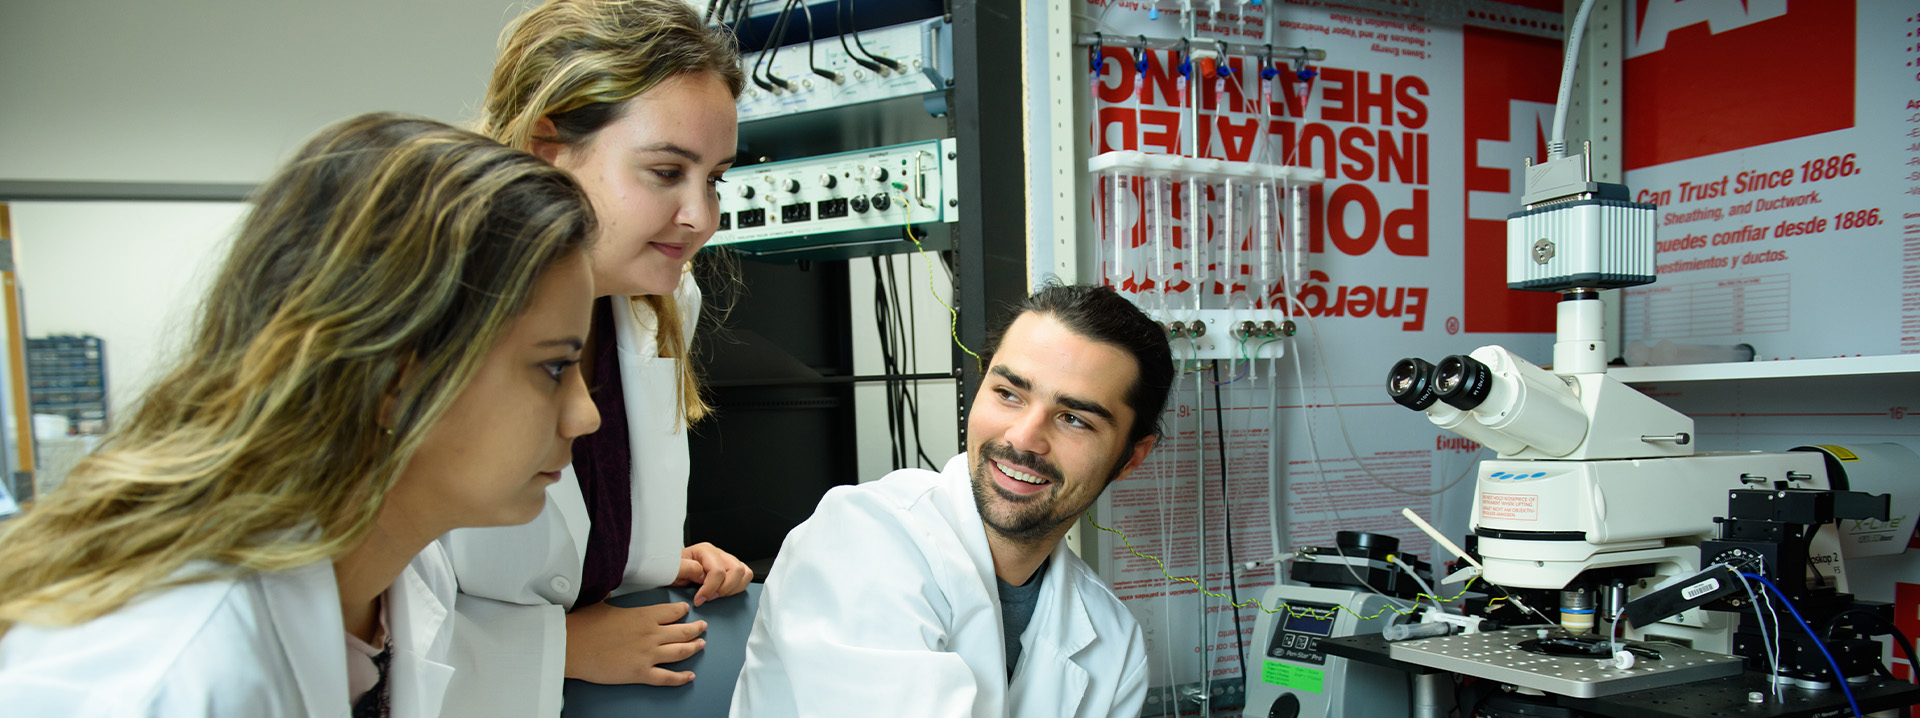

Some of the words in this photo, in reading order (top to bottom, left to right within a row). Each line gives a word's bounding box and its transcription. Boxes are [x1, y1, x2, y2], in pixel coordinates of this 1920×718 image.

[1330, 14, 1362, 26] R-Value
[1365, 18, 1405, 32] Insulation
[1279, 20, 1330, 35] Penetration
[1333, 27, 1356, 38] Vapor
[1359, 31, 1374, 40] and
[1376, 33, 1388, 41] Air
[1391, 35, 1426, 47] Reduces
[1371, 44, 1400, 56] Energy
[1402, 49, 1425, 59] Saves
[1088, 46, 1430, 129] SHEATHING
[1090, 107, 1429, 187] INSULATED
[1637, 189, 1671, 207] Can
[1678, 175, 1730, 203] Trust
[1734, 167, 1794, 194] Since
[1799, 152, 1862, 184] 1886.
[1663, 207, 1725, 227] Sheathing,
[1728, 200, 1753, 217] and
[1755, 190, 1823, 213] Ductwork.
[1712, 224, 1770, 248] confiar
[1774, 216, 1827, 239] desde
[1833, 207, 1885, 231] 1886.
[1730, 254, 1740, 270] y
[1741, 248, 1789, 266] ductos.
[1437, 435, 1480, 454] thing
[1811, 553, 1832, 565] oskop
[1833, 552, 1839, 562] 2
[1216, 655, 1240, 664] xterior
